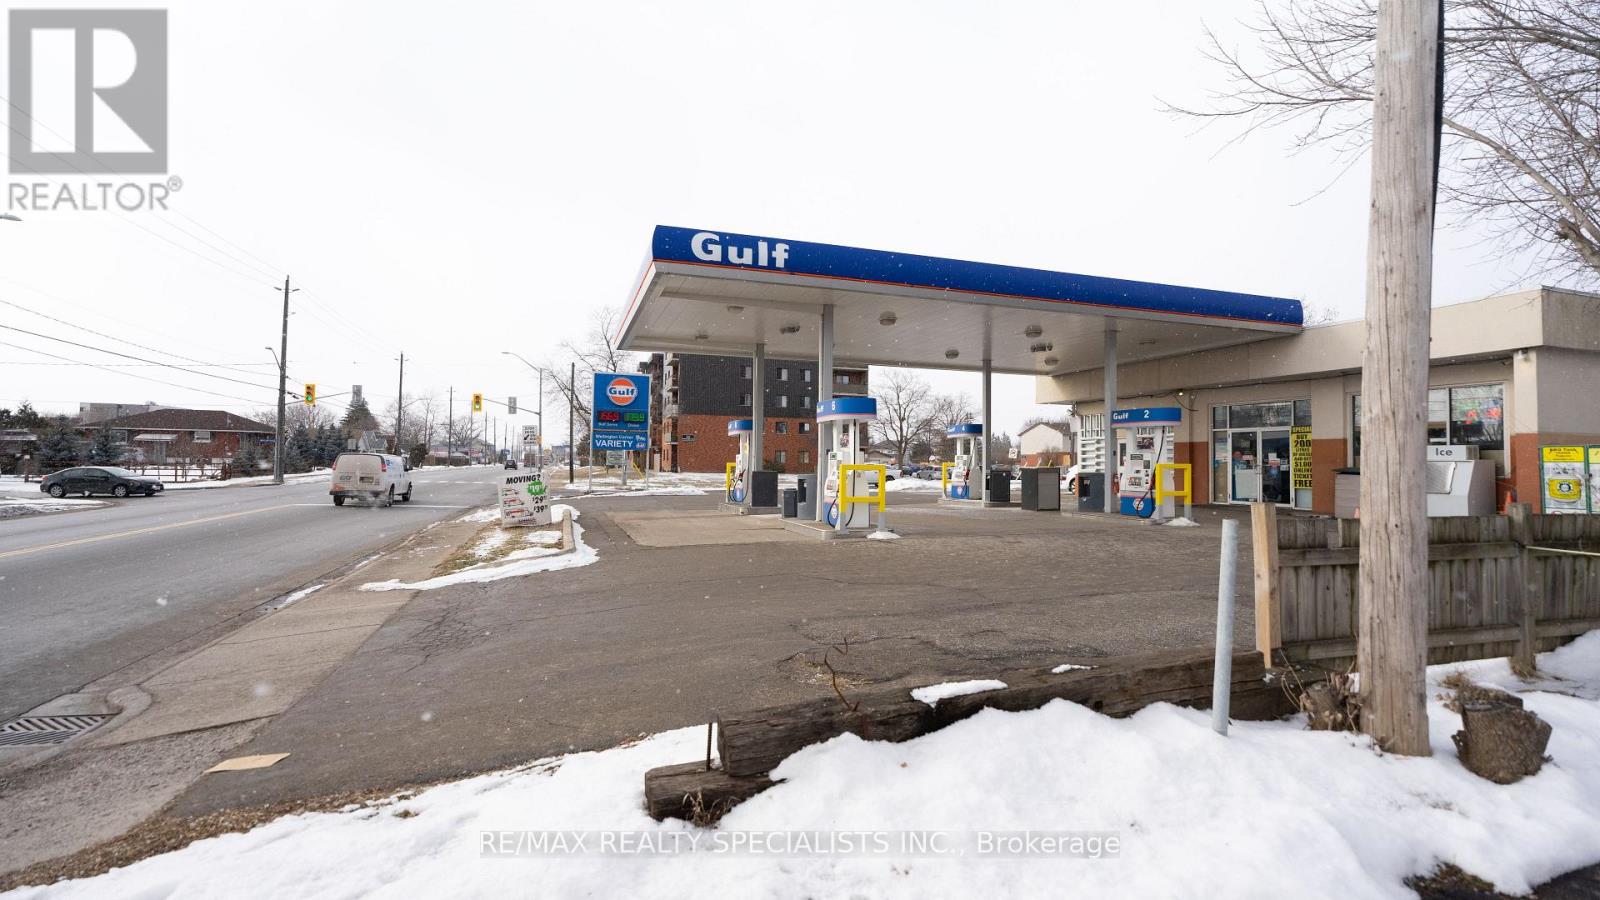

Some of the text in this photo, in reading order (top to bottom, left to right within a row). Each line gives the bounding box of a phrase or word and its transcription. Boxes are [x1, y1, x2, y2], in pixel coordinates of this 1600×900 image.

[691, 232, 789, 269] Gulf
[609, 387, 635, 396] Gulf
[1144, 410, 1149, 418] 2
[595, 440, 633, 448] VARIETY
[1435, 447, 1453, 456] Ice
[506, 474, 541, 484] MOVING?
